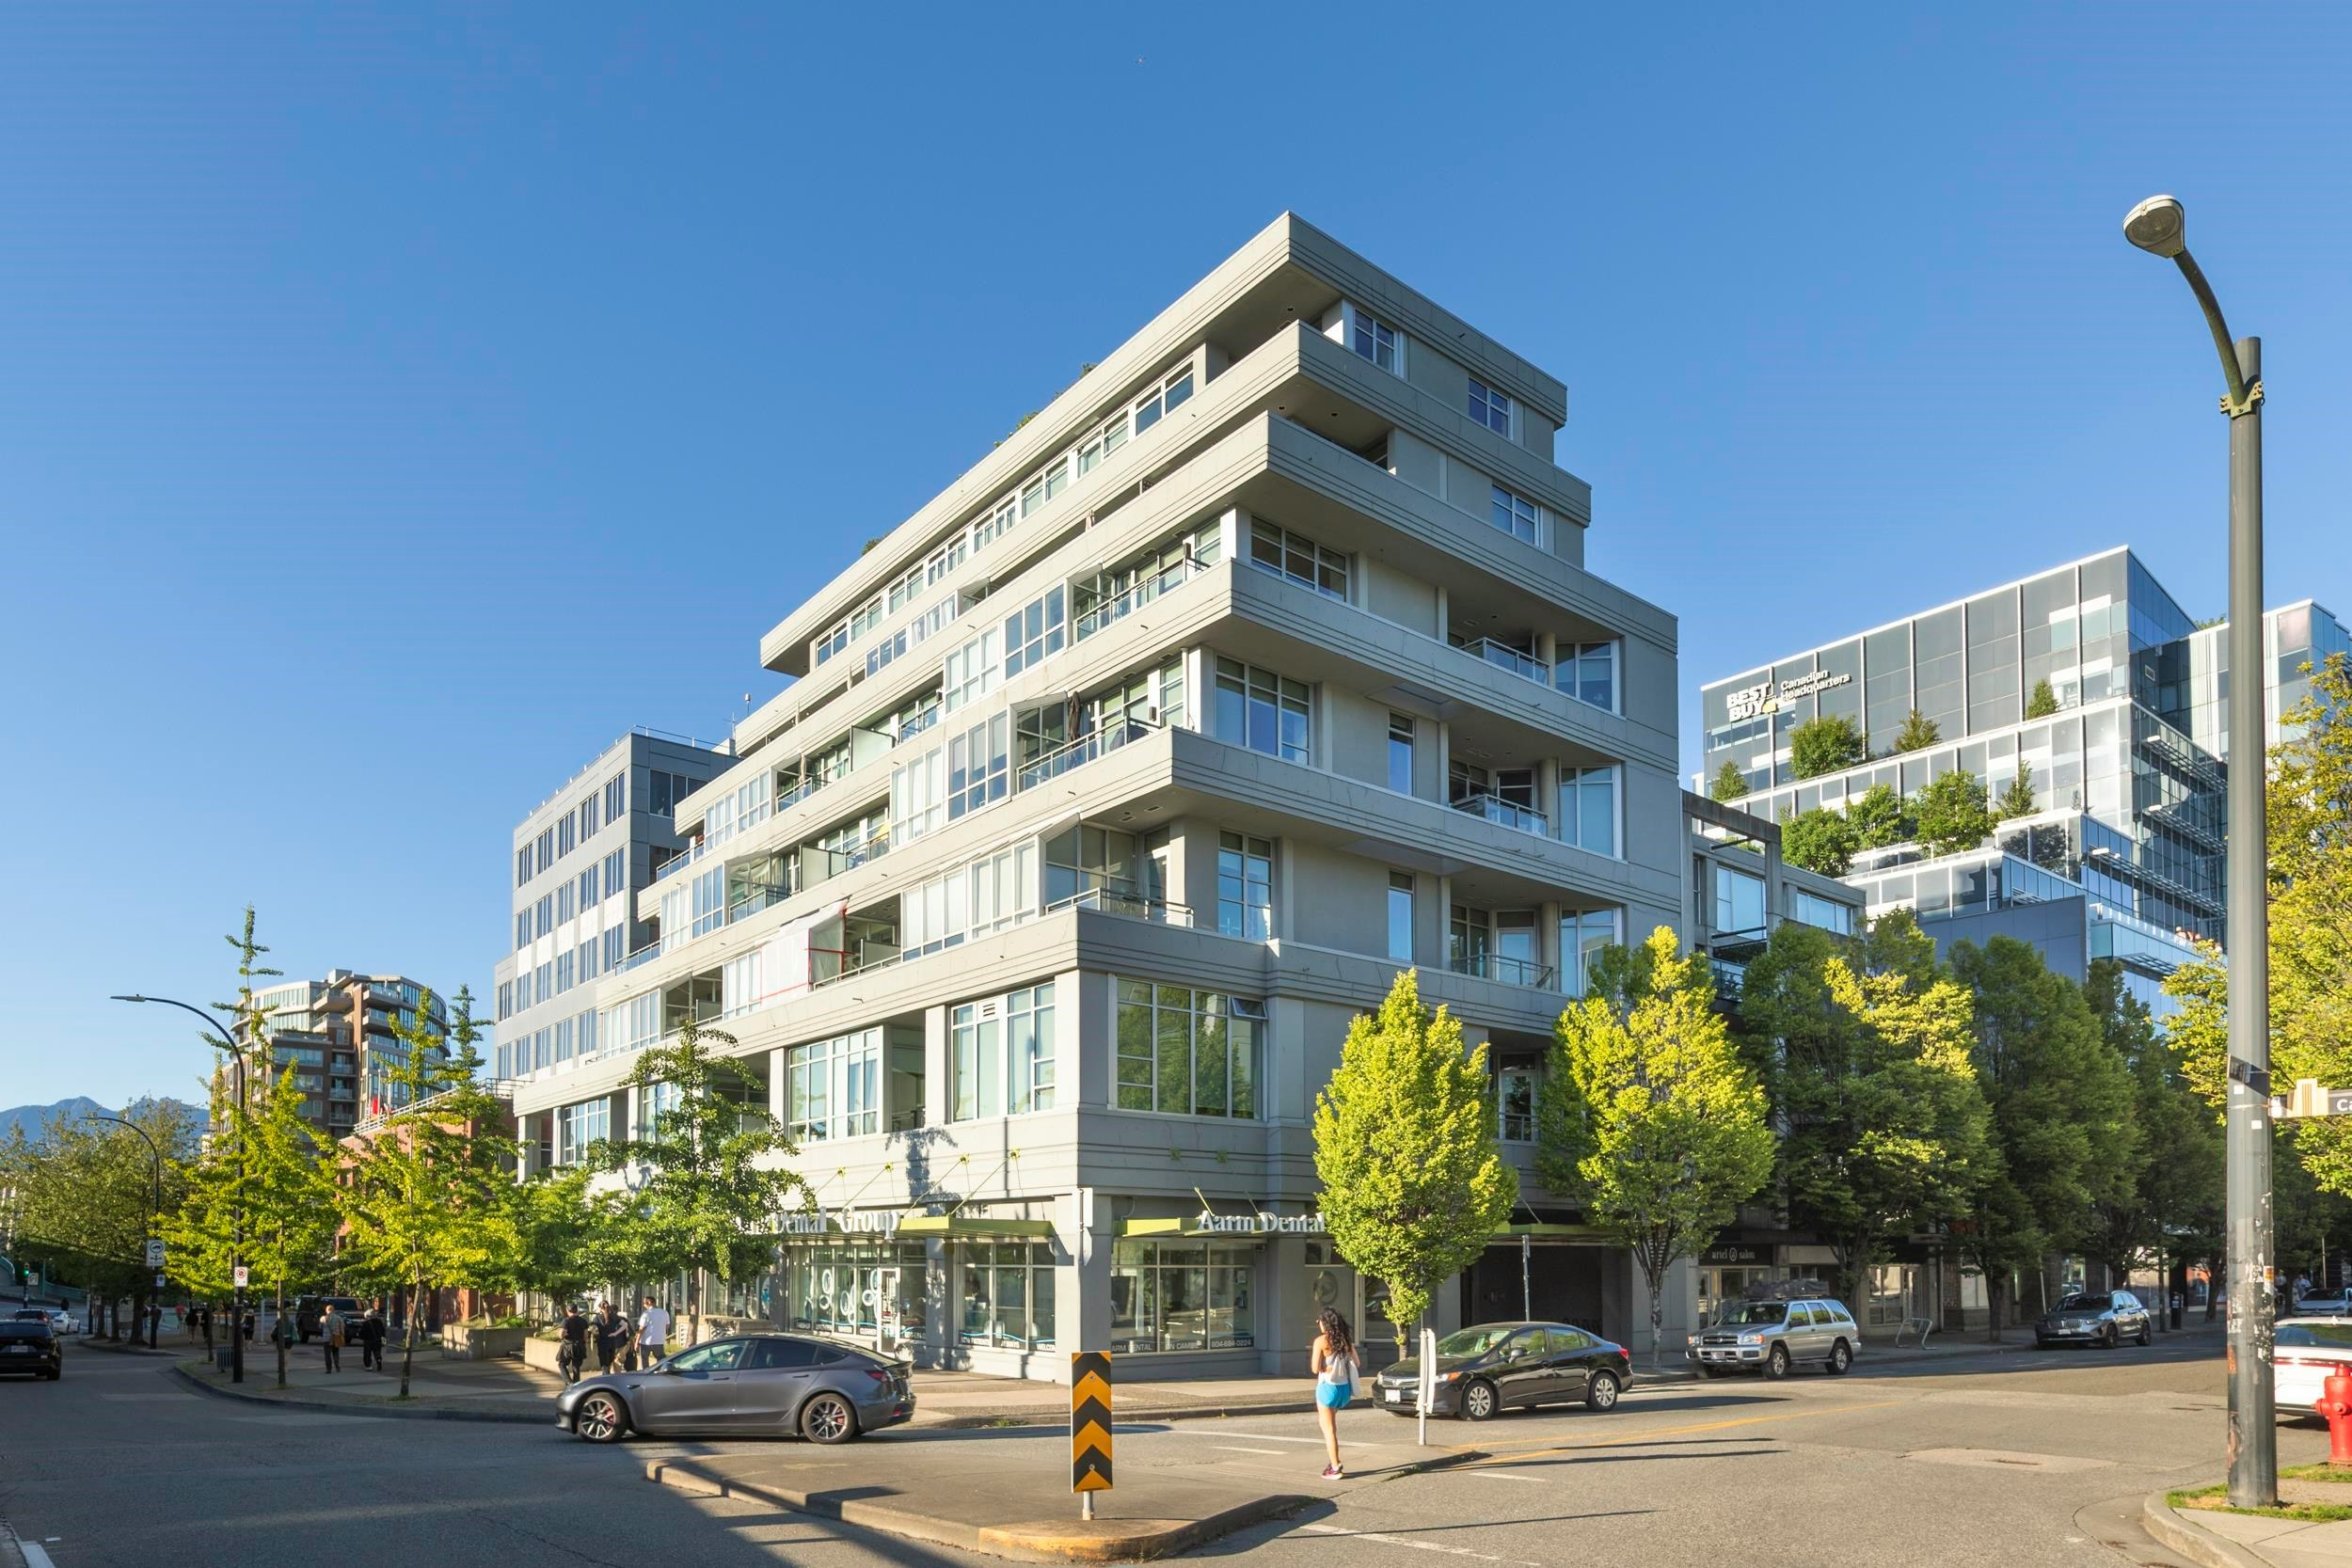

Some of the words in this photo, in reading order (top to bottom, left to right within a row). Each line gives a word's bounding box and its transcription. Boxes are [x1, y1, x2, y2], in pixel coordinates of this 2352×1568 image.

[1780, 669, 1829, 691] Canadian
[1781, 673, 1851, 702] Headquarters
[1726, 682, 1771, 709] BEST
[1729, 697, 1766, 722] BUY
[837, 1205, 900, 1240] Group
[1196, 1210, 1255, 1232] Aarm
[1258, 1212, 1326, 1232] Dental
